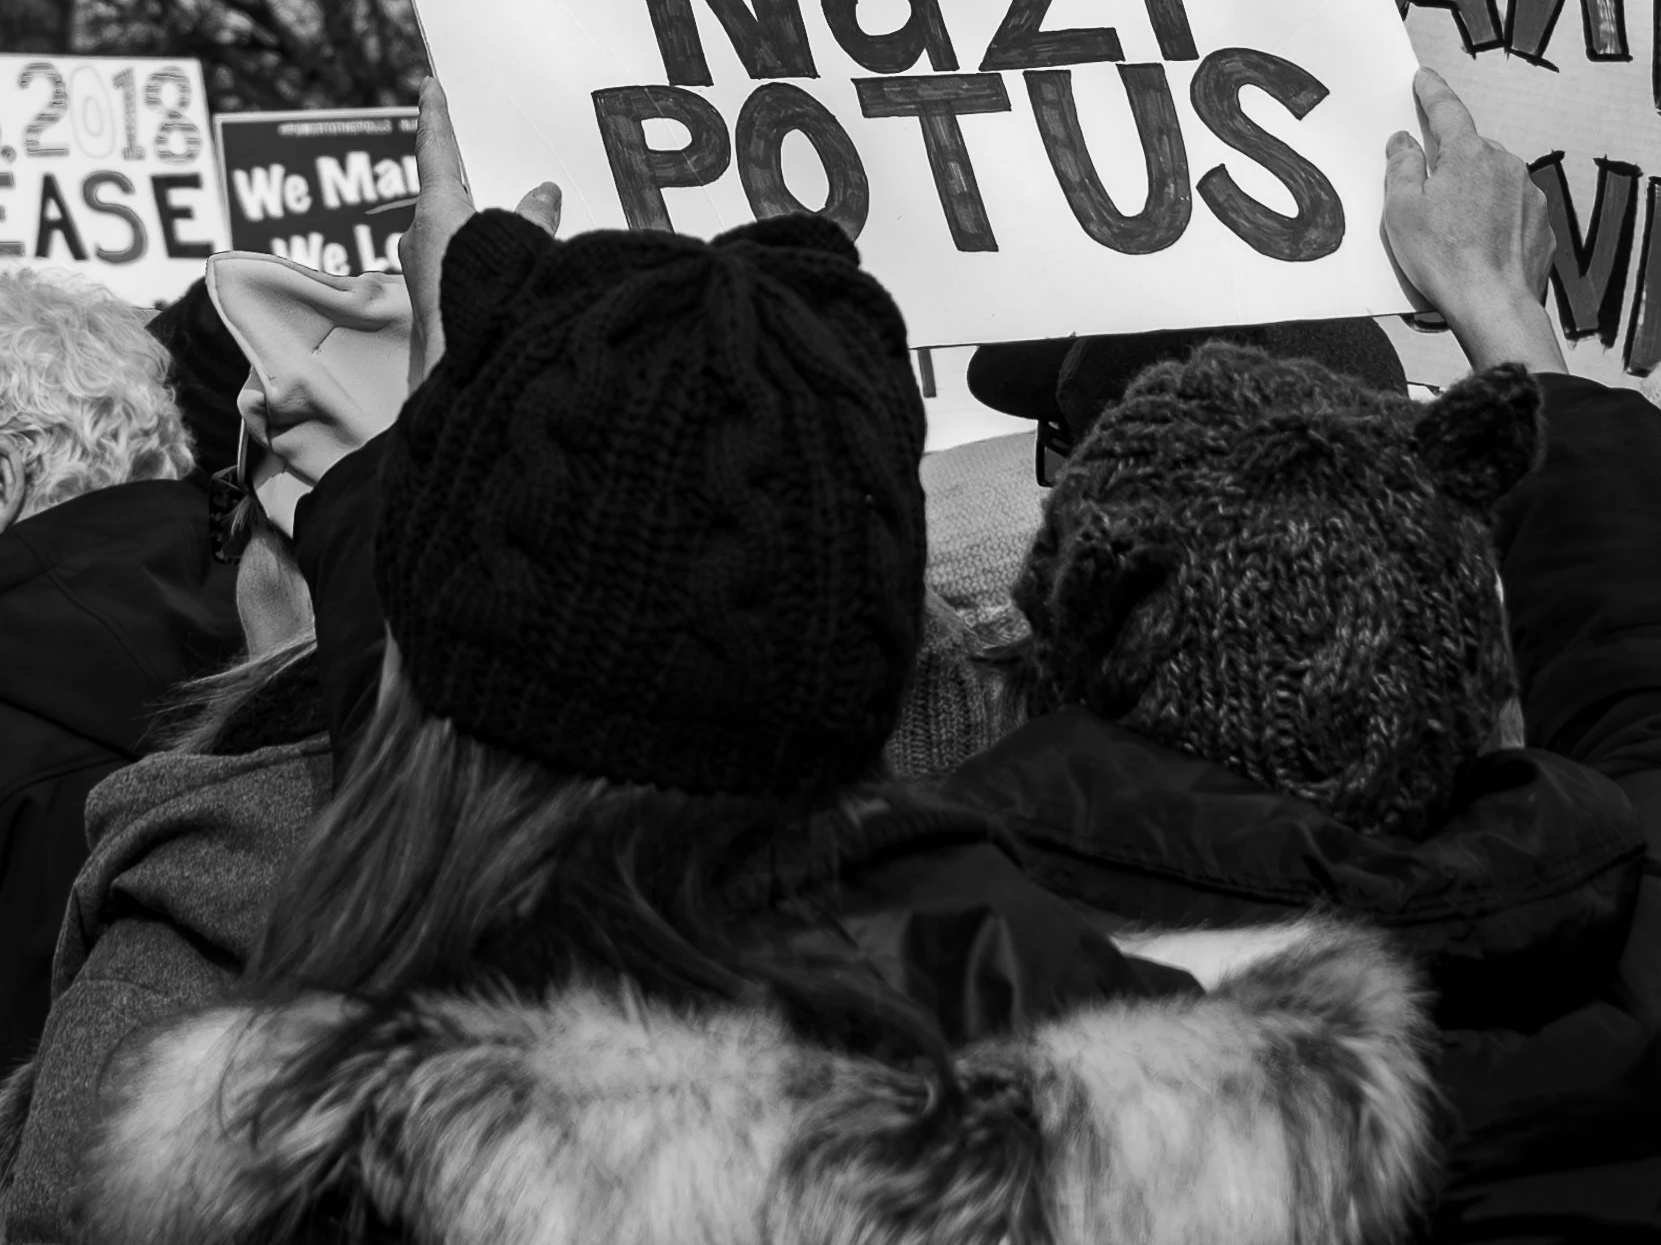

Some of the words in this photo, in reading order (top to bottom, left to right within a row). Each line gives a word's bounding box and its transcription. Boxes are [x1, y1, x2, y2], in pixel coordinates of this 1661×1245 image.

[591, 47, 1345, 262] POTUS
[232, 164, 312, 222] We
[271, 231, 351, 276] We
